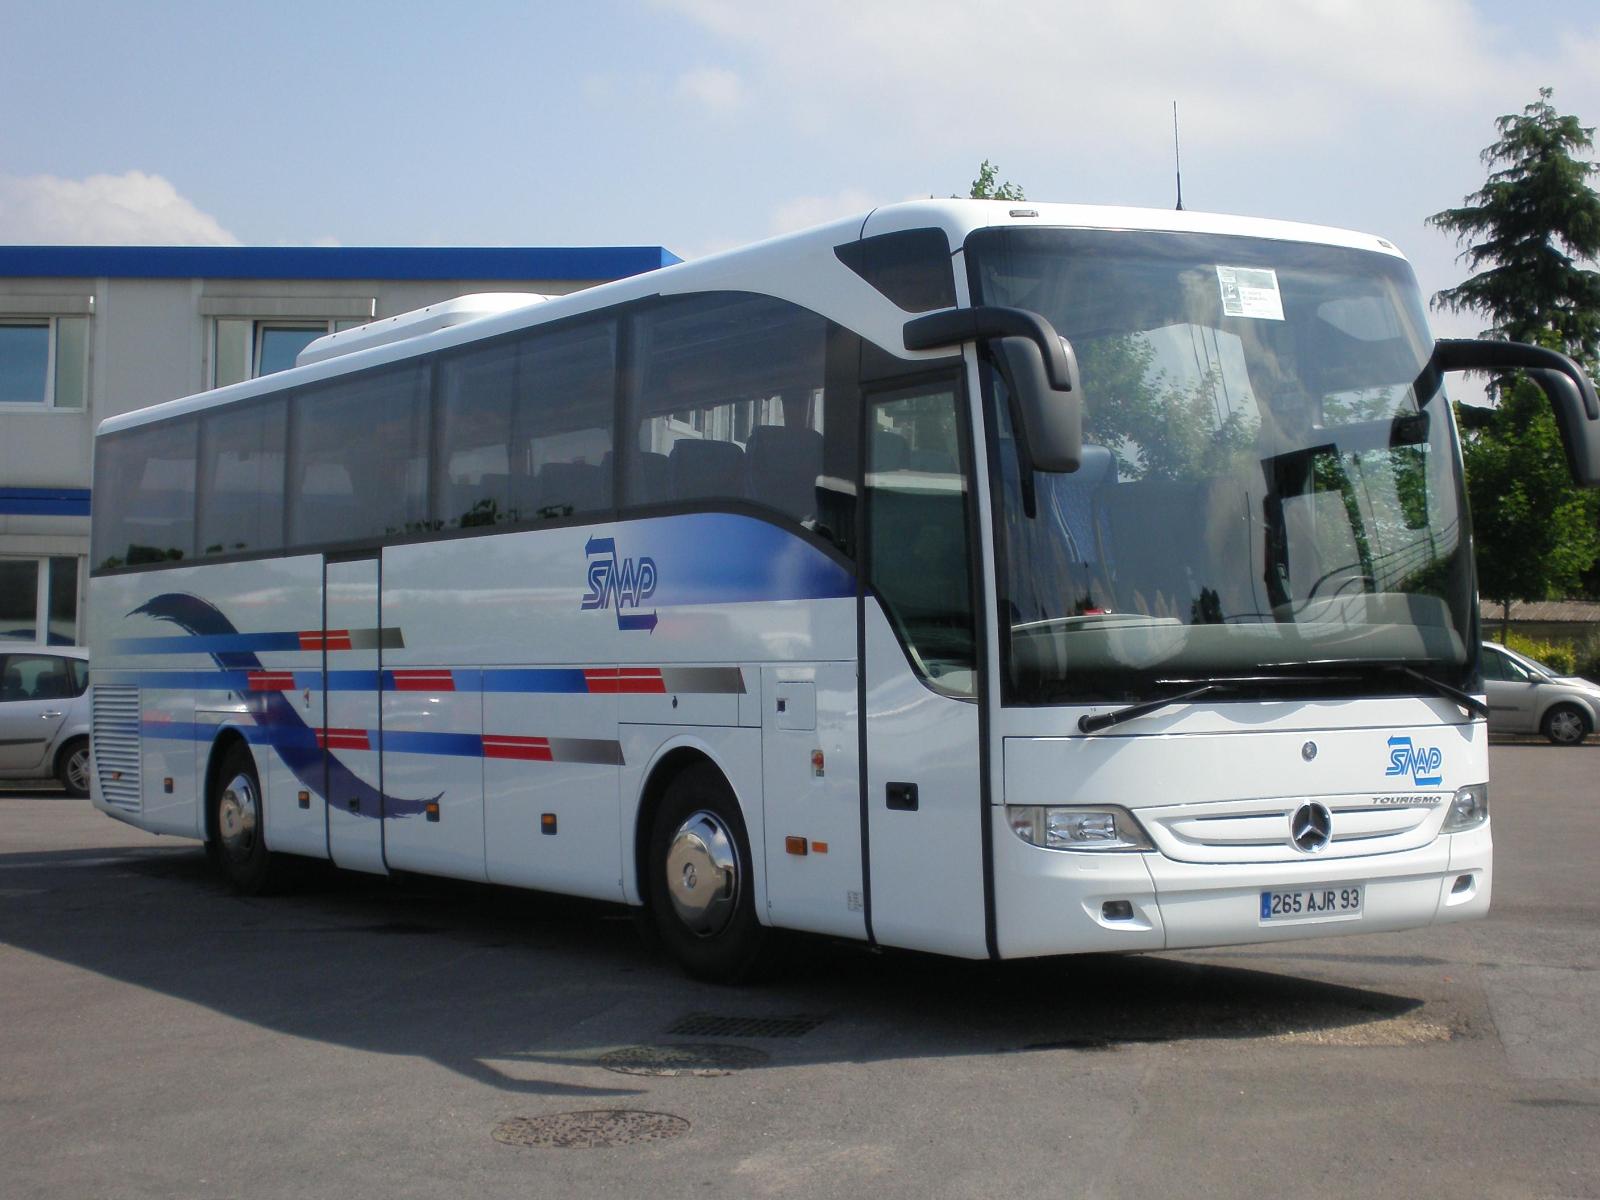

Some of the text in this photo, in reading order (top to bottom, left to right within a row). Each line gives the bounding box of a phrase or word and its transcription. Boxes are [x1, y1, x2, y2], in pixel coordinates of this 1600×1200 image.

[581, 551, 658, 615] SNAP
[1385, 744, 1442, 779] SNAP
[1372, 796, 1442, 804] TOURISMO
[1272, 889, 1359, 914] 265 AJR 93
